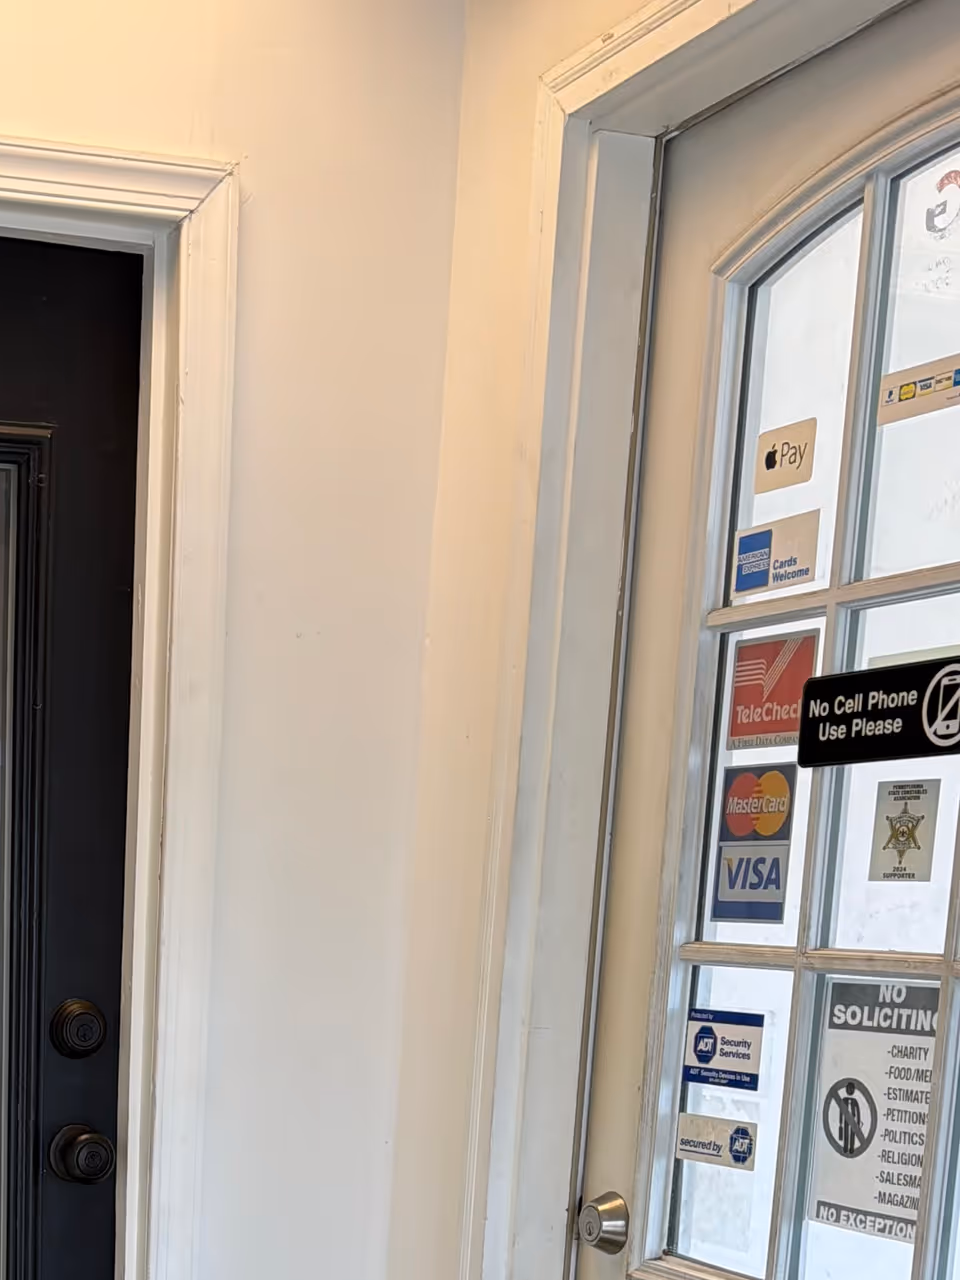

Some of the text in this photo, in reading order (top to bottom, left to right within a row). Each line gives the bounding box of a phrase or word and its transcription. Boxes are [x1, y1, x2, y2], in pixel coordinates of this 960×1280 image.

[780, 442, 808, 470] Pay
[738, 548, 769, 564] AMERICAN
[773, 556, 797, 571] Cards
[743, 561, 769, 574] EXPRESS
[772, 567, 810, 583] Welcome
[809, 690, 918, 718] No Cell Phone
[818, 718, 903, 741] Use Please
[726, 794, 787, 815] MasterCard
[723, 857, 780, 890] VISA
[878, 984, 907, 1004] NO
[697, 1038, 714, 1052] ADT
[720, 1036, 752, 1051] Security
[719, 1047, 751, 1061] Services
[680, 1137, 723, 1153] secured by
[733, 1138, 750, 1152] ADT
[820, 1205, 916, 1239] NO EXCEPTION
